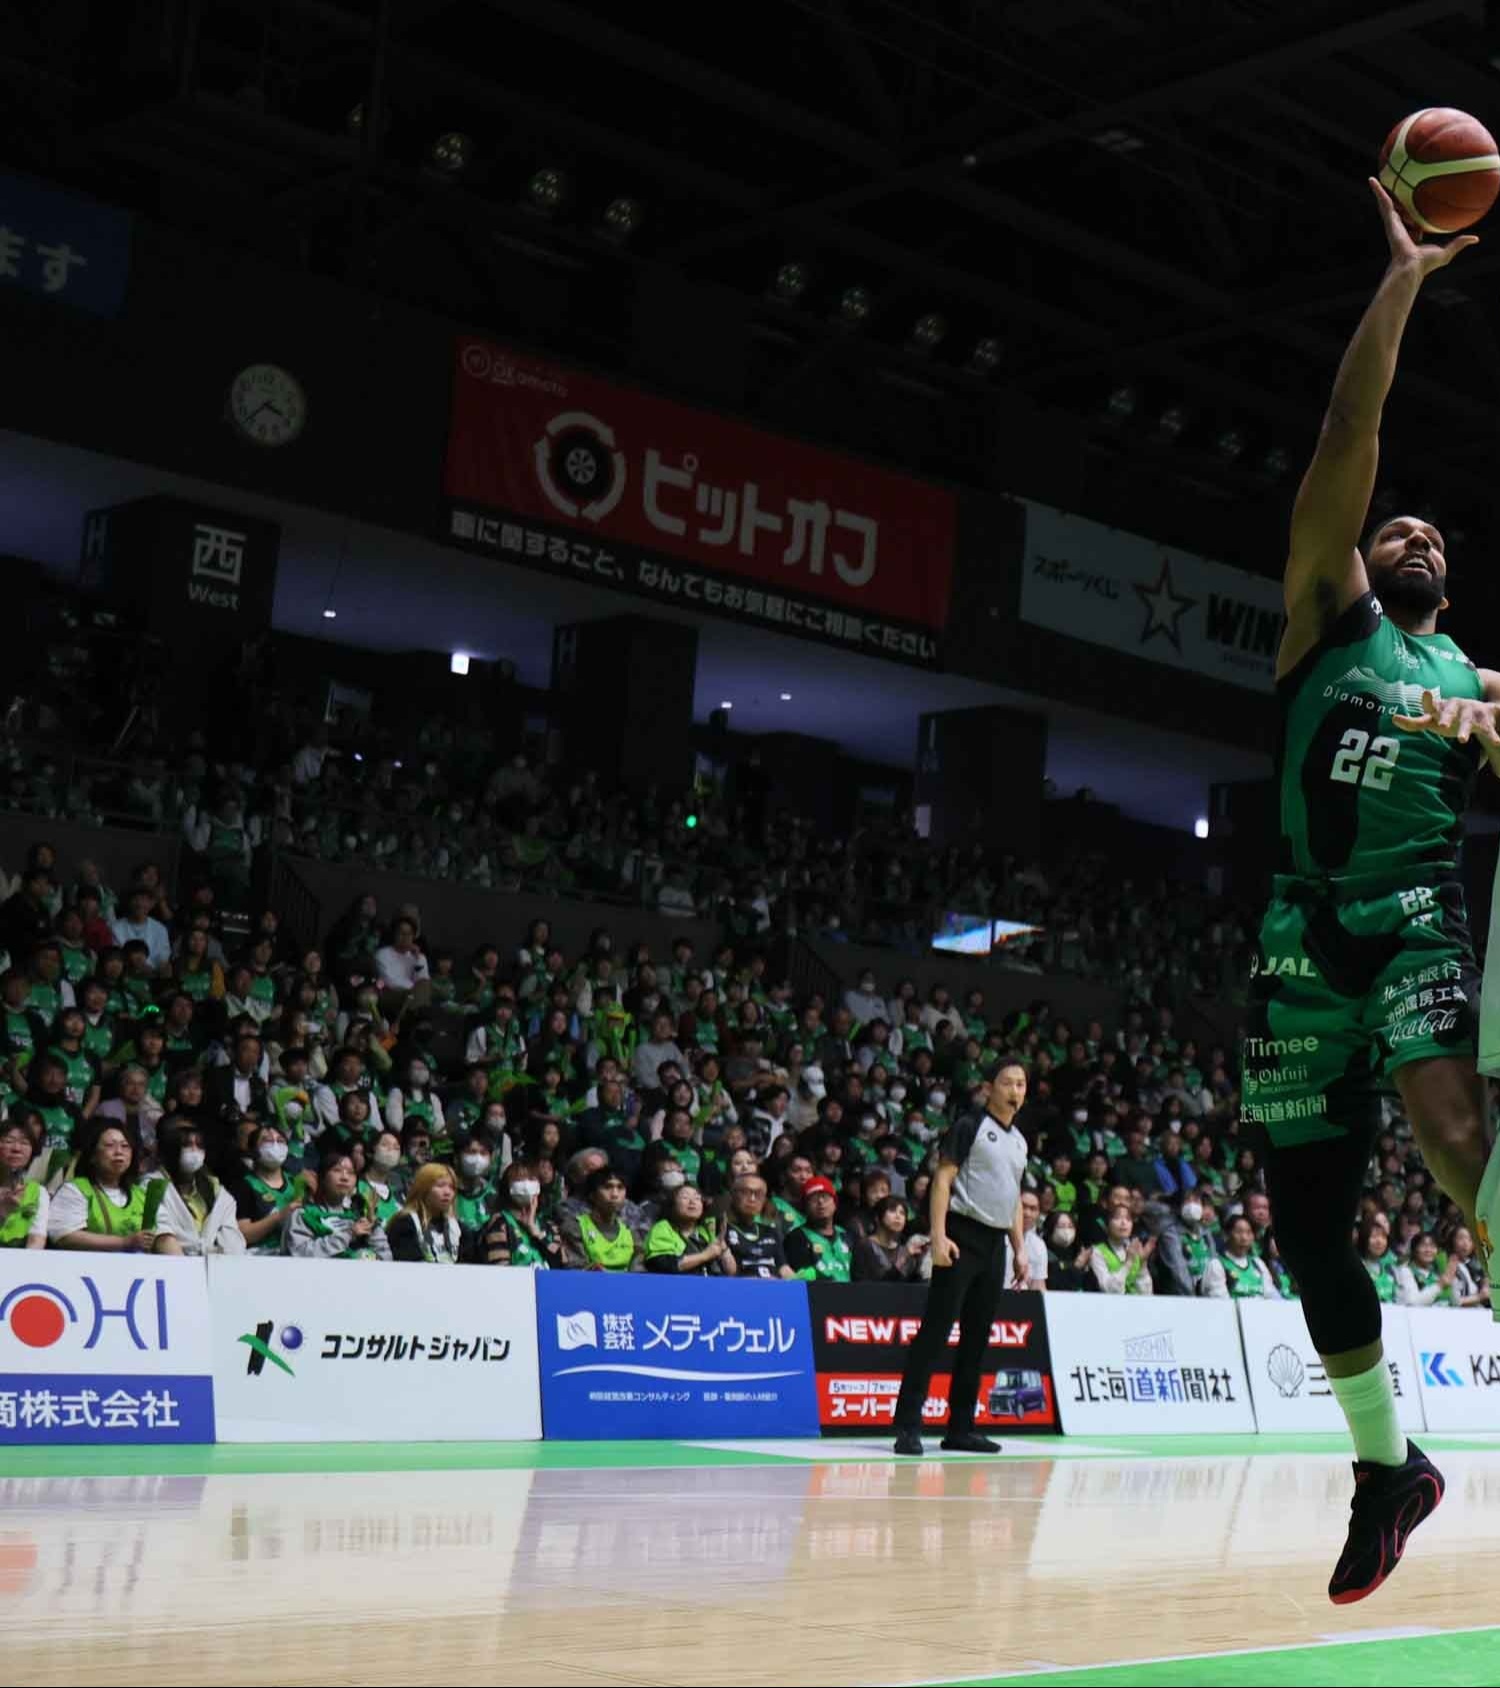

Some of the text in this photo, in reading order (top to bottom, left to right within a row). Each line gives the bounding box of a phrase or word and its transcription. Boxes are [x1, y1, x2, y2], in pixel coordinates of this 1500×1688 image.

[642, 448, 879, 587] ピットオフ
[191, 523, 247, 585] 西
[187, 582, 240, 610] West
[1322, 685, 1399, 716] Diamond
[1328, 727, 1400, 792] 22
[1399, 886, 1435, 916] 22
[1261, 956, 1318, 978] JAL
[1250, 1036, 1320, 1059] Timee
[642, 1314, 797, 1353] メディウェル
[825, 1316, 897, 1344] NEW
[321, 1334, 511, 1361] コンサルトジャパン
[1071, 1367, 1236, 1402] 北海道新聞社
